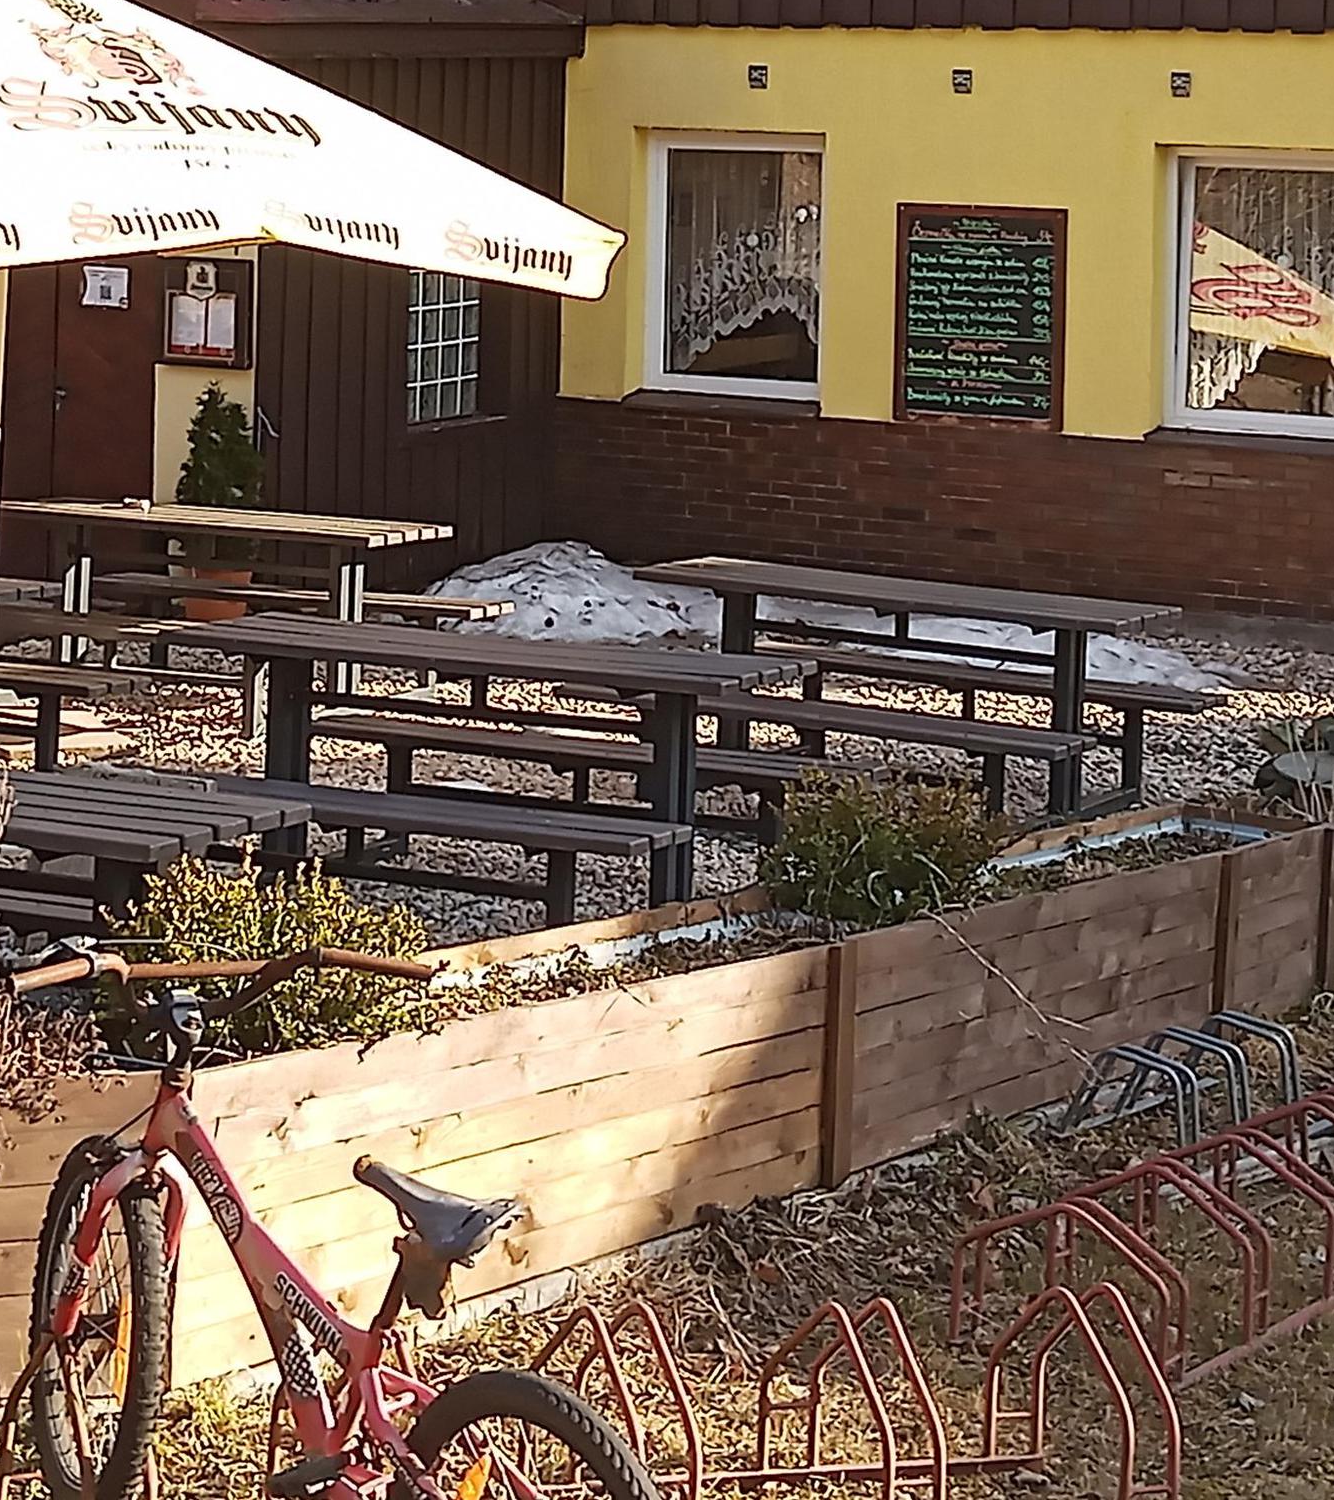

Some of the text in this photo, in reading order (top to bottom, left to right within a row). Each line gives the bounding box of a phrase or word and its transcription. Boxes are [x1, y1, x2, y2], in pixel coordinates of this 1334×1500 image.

[68, 201, 220, 245] Svijany
[444, 218, 572, 281] Svijany
[273, 1271, 344, 1357] SCHWINN
